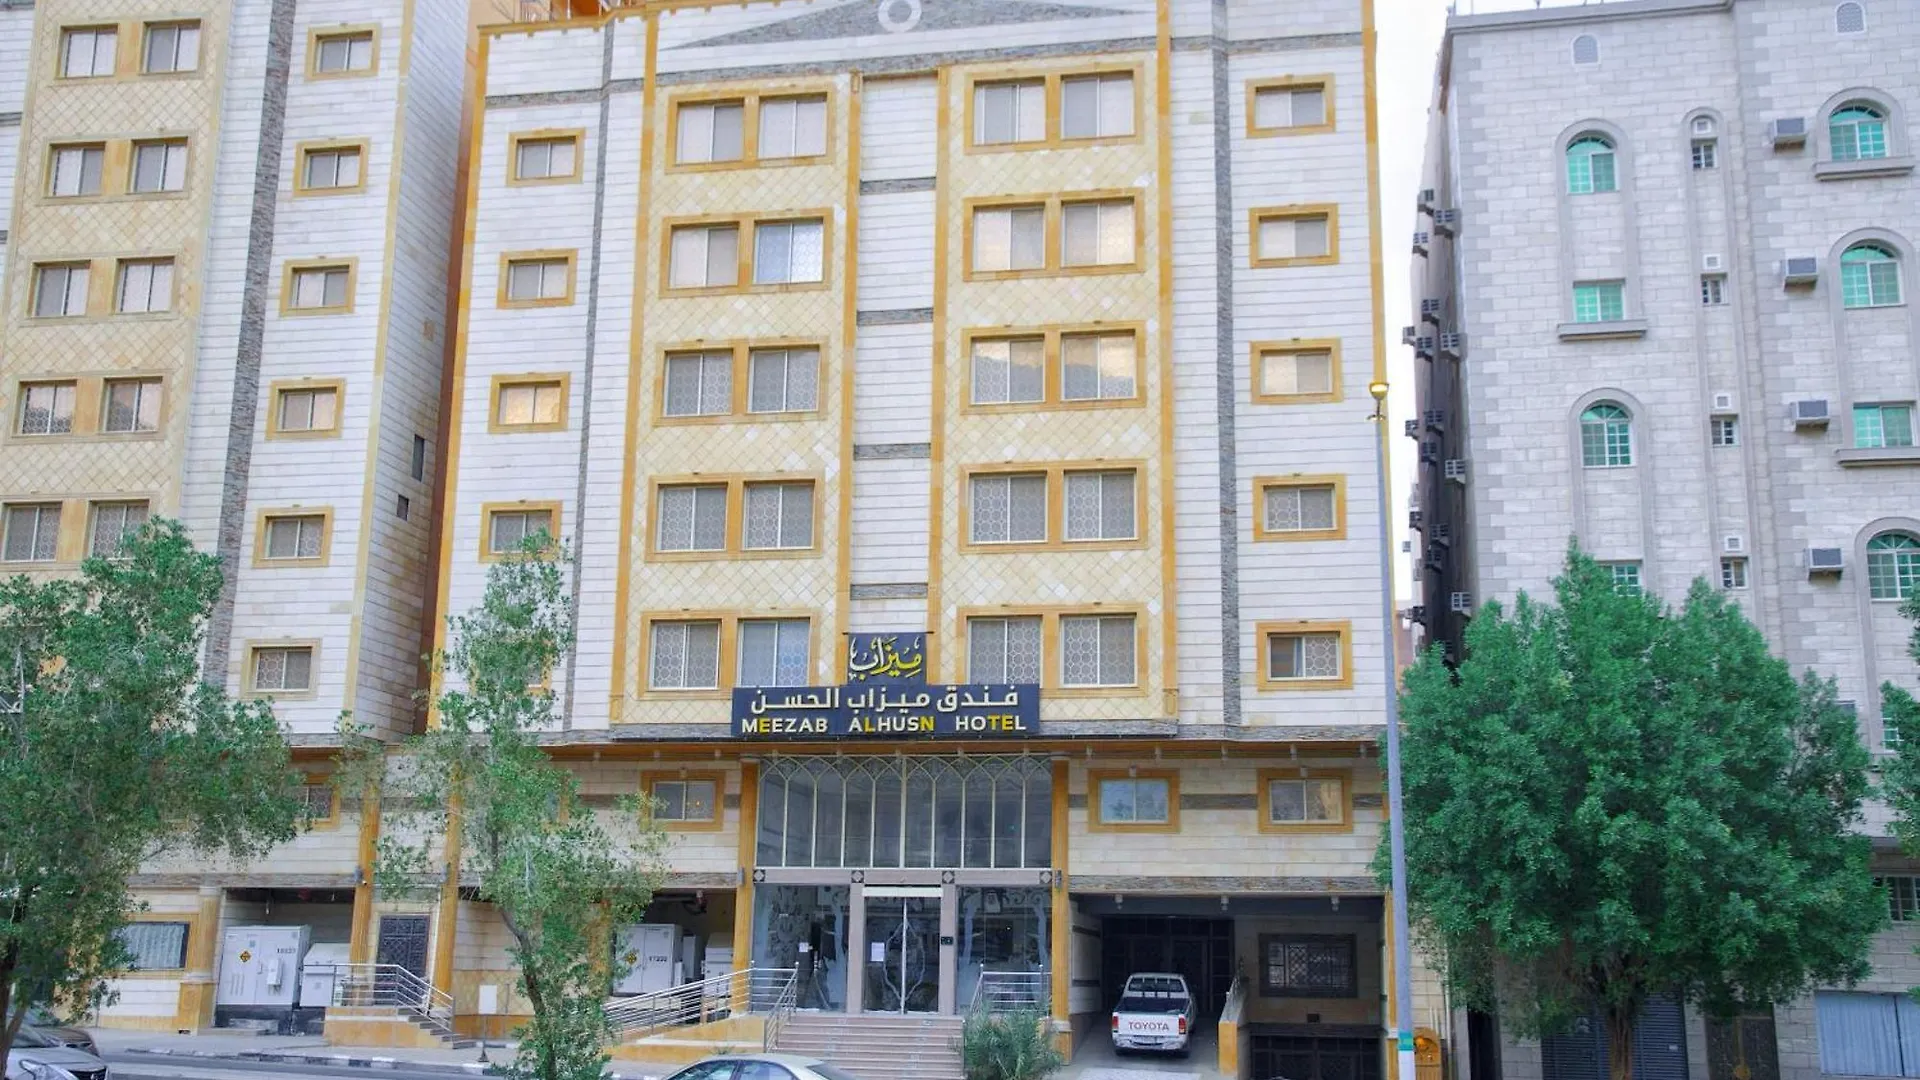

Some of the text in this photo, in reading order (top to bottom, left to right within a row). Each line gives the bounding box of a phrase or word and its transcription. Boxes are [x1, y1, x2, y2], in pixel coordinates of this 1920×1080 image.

[751, 685, 1018, 714] فندق ميزاب الحسن
[742, 714, 1026, 733] MEEZAB ALHUSN HOTEL
[1128, 1021, 1170, 1031] TOYOTA
